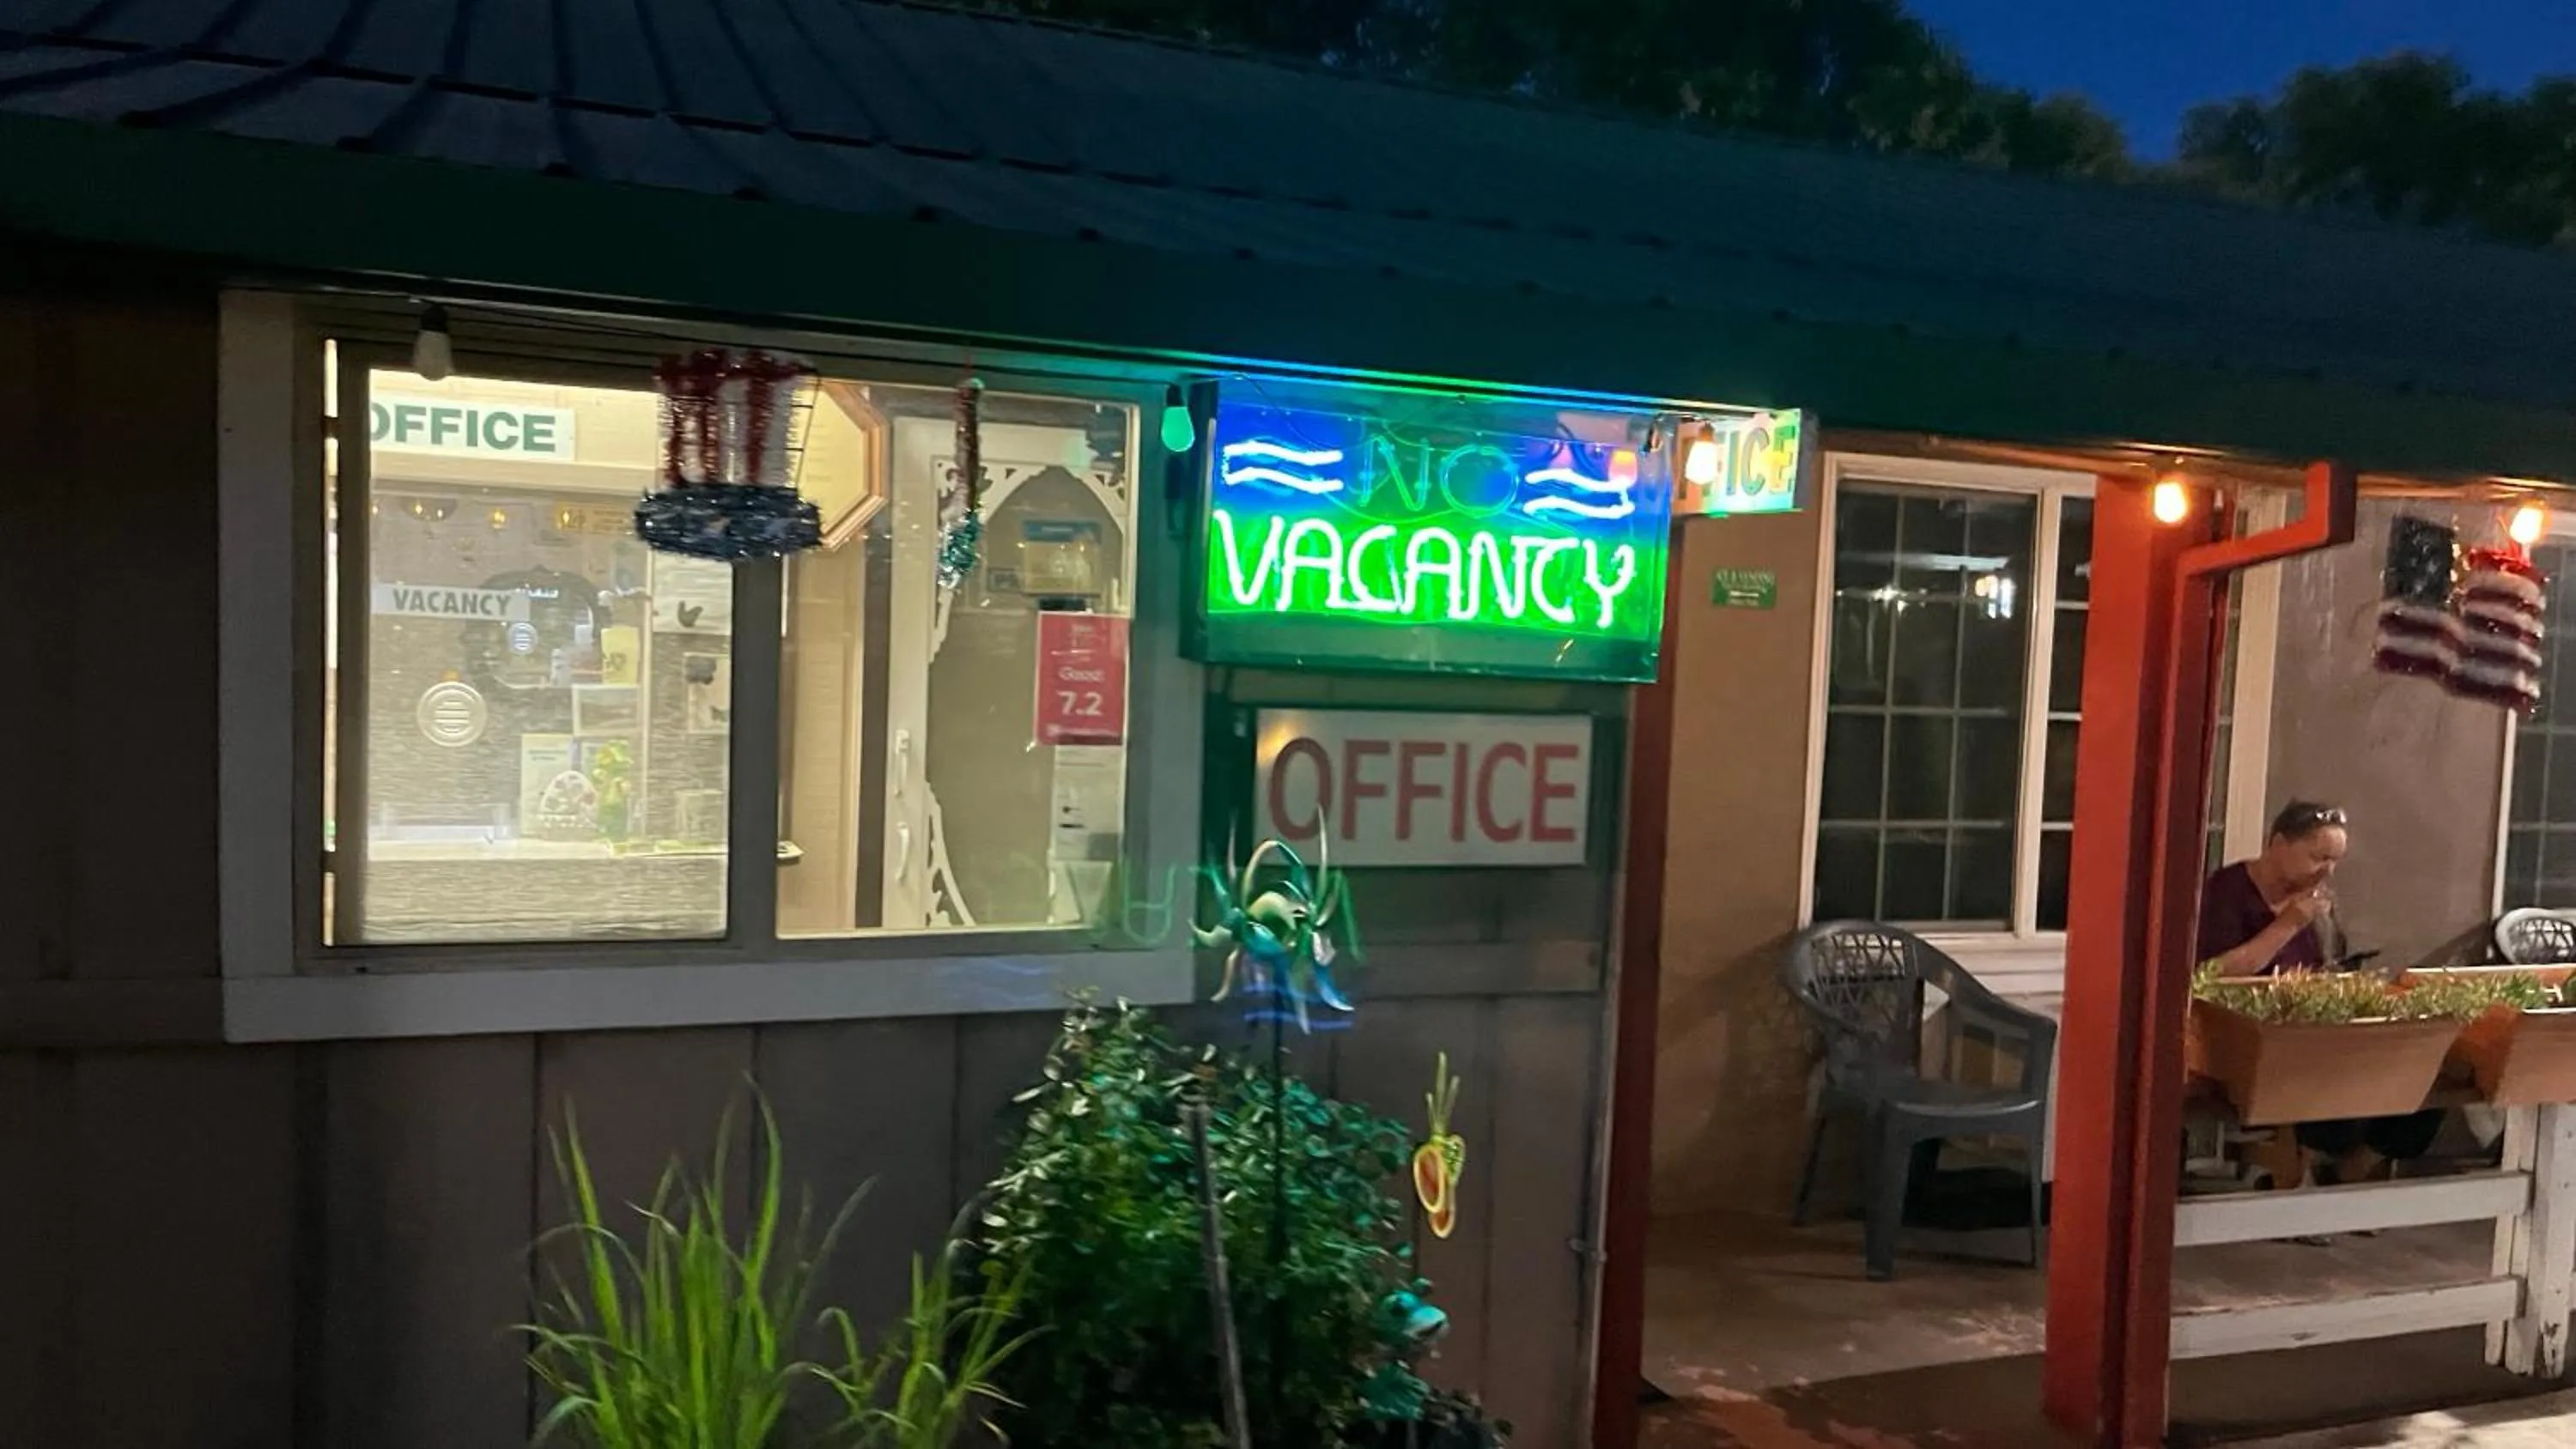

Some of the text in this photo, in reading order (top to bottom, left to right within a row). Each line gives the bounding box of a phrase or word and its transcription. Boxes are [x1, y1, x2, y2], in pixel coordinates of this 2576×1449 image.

[1358, 434, 1518, 513] NO
[392, 589, 510, 616] VACANCY
[1212, 510, 1635, 627] VACANCY
[1057, 690, 1103, 716] 7.2
[1269, 737, 1580, 843] OFFICE
